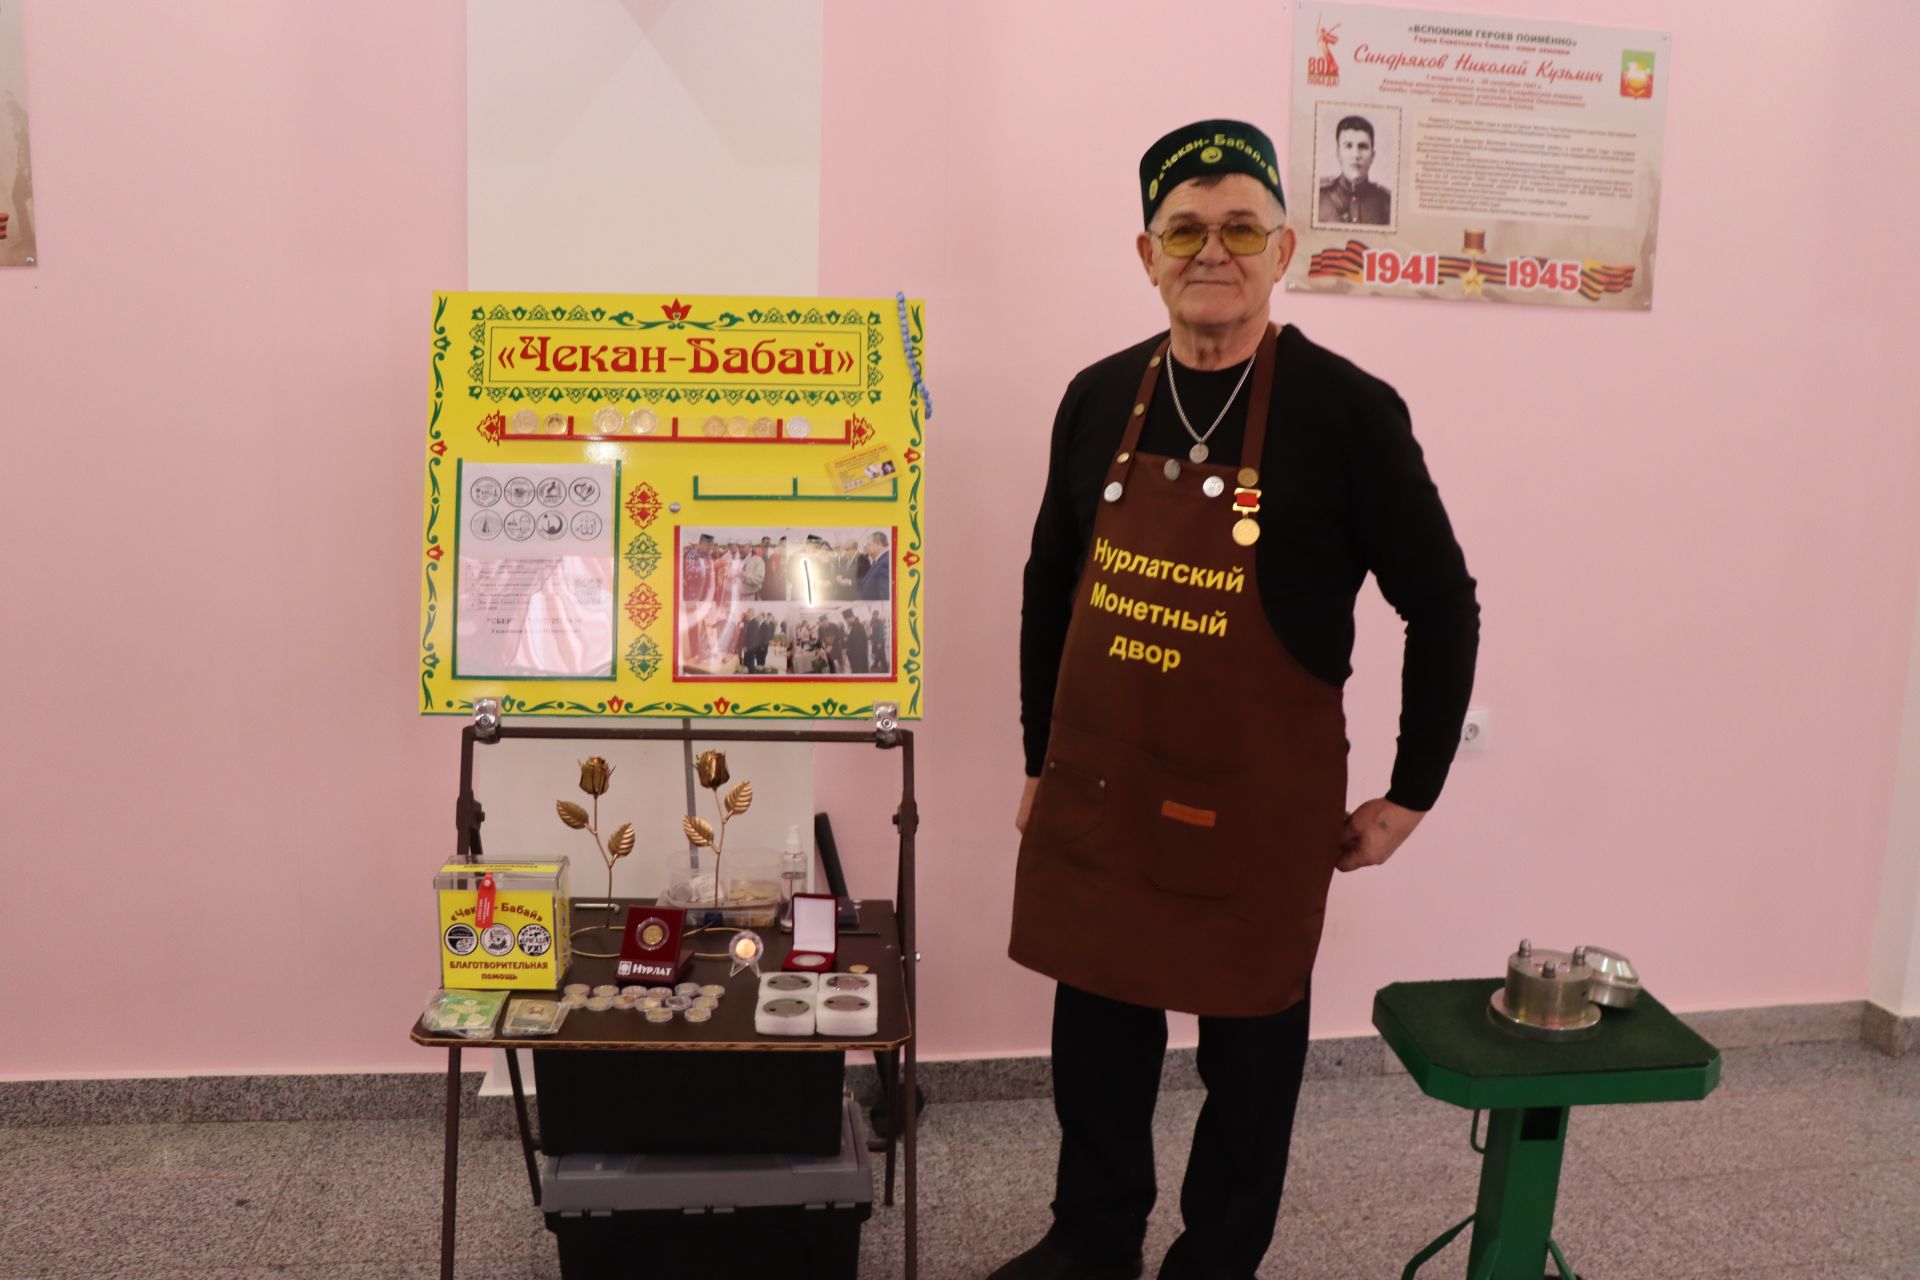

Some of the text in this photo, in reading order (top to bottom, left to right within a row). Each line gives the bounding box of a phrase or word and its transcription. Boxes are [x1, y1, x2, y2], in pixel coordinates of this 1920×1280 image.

[1408, 25, 1473, 38] «ВСПОМНИМ
[1475, 31, 1513, 41] ГЕРОЕВ
[1353, 43, 1449, 71] Синдряков
[1455, 52, 1528, 76] Николай
[1536, 60, 1603, 83] Кузьмич
[1365, 251, 1580, 292] 1941 1945
[498, 336, 855, 376] «Чекан-Бабай»
[1094, 537, 1245, 593] Нурлатский
[1090, 582, 1228, 637] Монетный
[1109, 635, 1181, 673] двор
[449, 960, 548, 970] БЛАГОТВОРИТЕЛЬНАЯ
